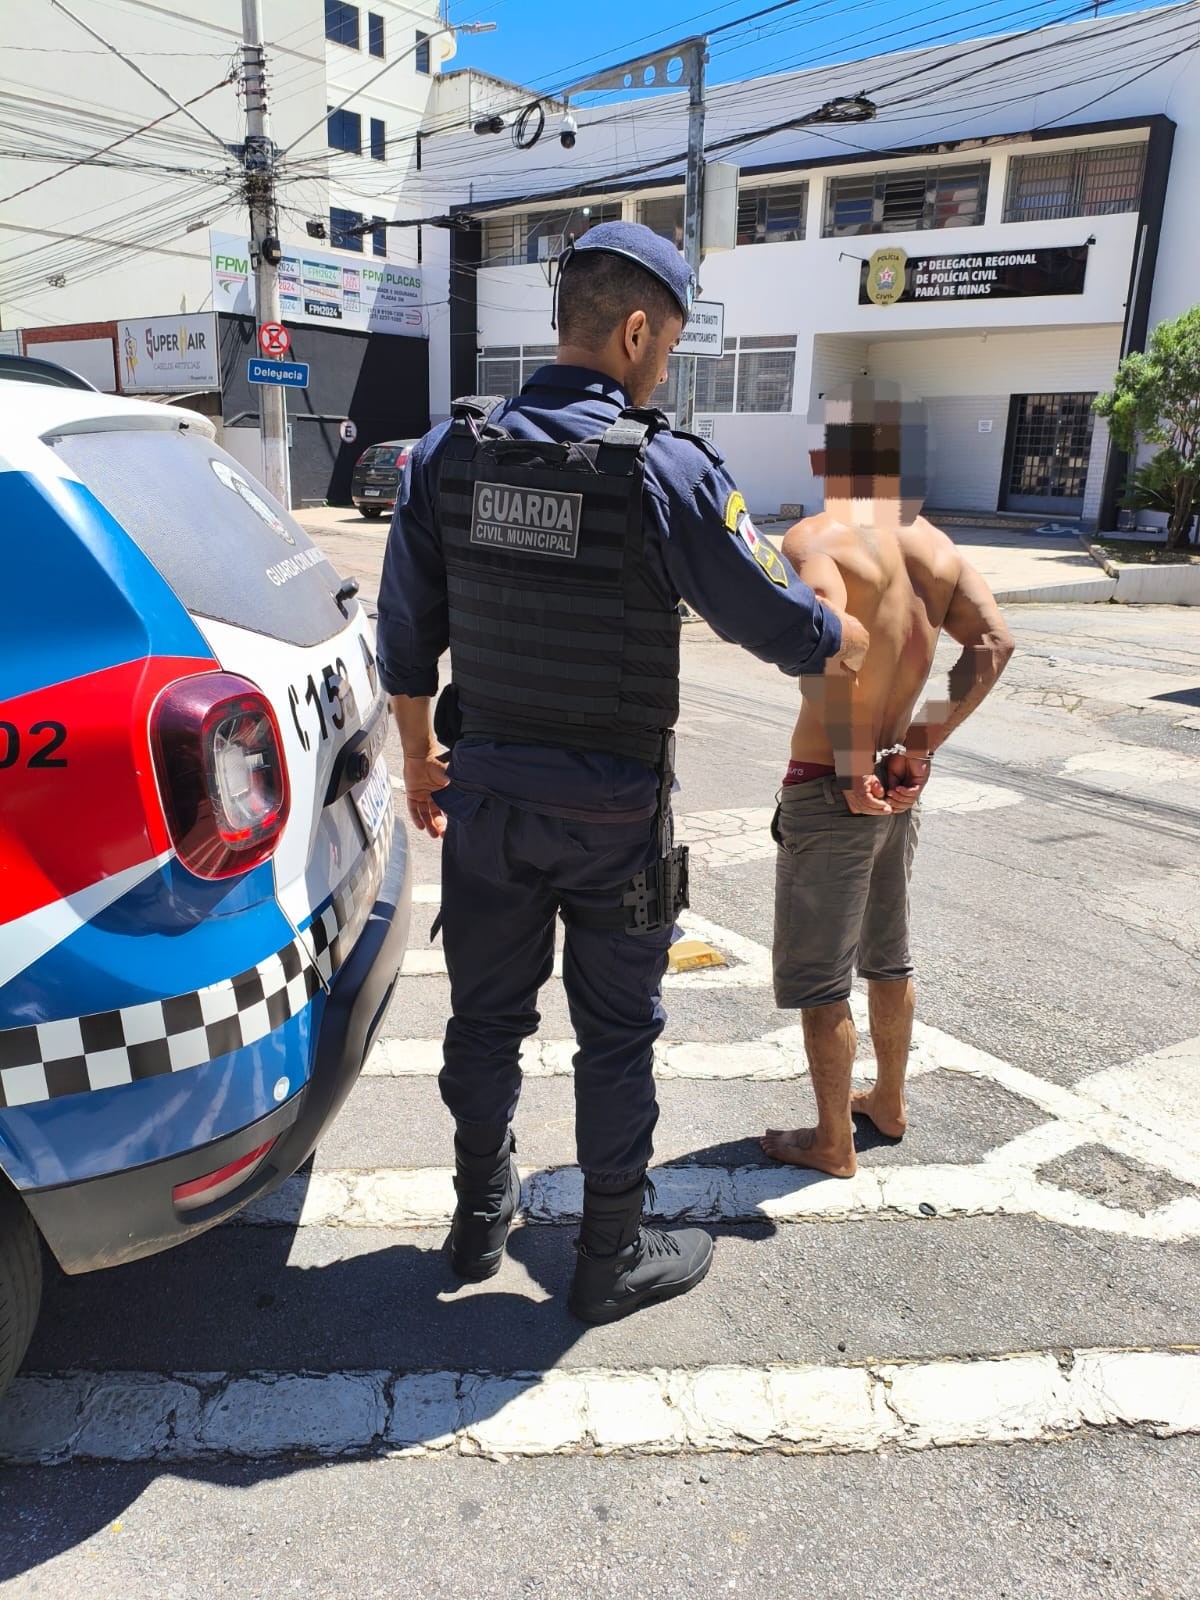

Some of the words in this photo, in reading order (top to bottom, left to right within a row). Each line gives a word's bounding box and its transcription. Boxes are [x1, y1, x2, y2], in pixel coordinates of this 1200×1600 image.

[215, 255, 249, 274] FPM
[278, 262, 295, 272] 2024
[929, 257, 983, 271] DELEGACIA
[985, 254, 1037, 267] REGIONAL
[362, 269, 384, 284] FPM
[386, 273, 421, 289] PLACAS
[916, 273, 929, 284] DE
[931, 270, 970, 284] POLÍCIA
[972, 270, 998, 281] CIVIL
[279, 281, 295, 292] 2024
[915, 285, 940, 298] PARÁ
[942, 286, 956, 296] DE
[957, 284, 991, 296] MINAS
[308, 304, 338, 317] FPM2024
[254, 366, 303, 381] Delegacia
[478, 488, 573, 531] GUARDA
[476, 524, 504, 541] CIVIL
[507, 529, 571, 552] MUNICIPAL
[265, 557, 303, 587] GUARDA
